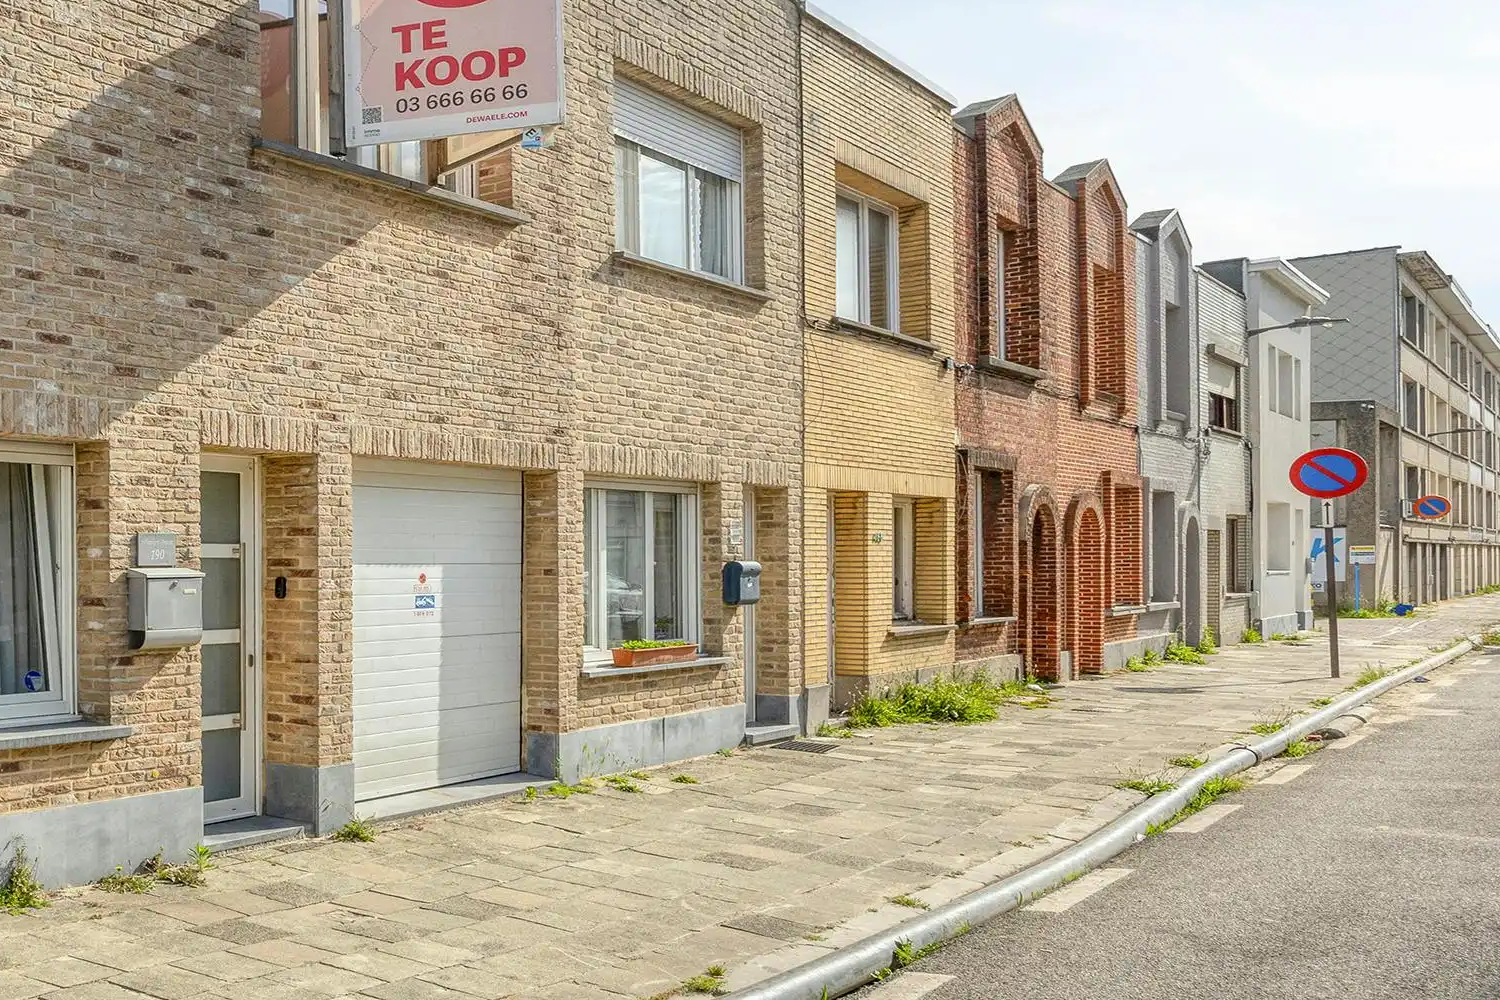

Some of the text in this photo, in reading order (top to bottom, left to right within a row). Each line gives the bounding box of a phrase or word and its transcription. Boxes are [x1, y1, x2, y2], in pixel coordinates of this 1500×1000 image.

[391, 19, 448, 54] TE
[395, 47, 527, 91] KOOP
[396, 83, 528, 113] 03 666 66 66
[466, 110, 528, 124] DEWAELE.COM
[151, 549, 165, 560] 190
